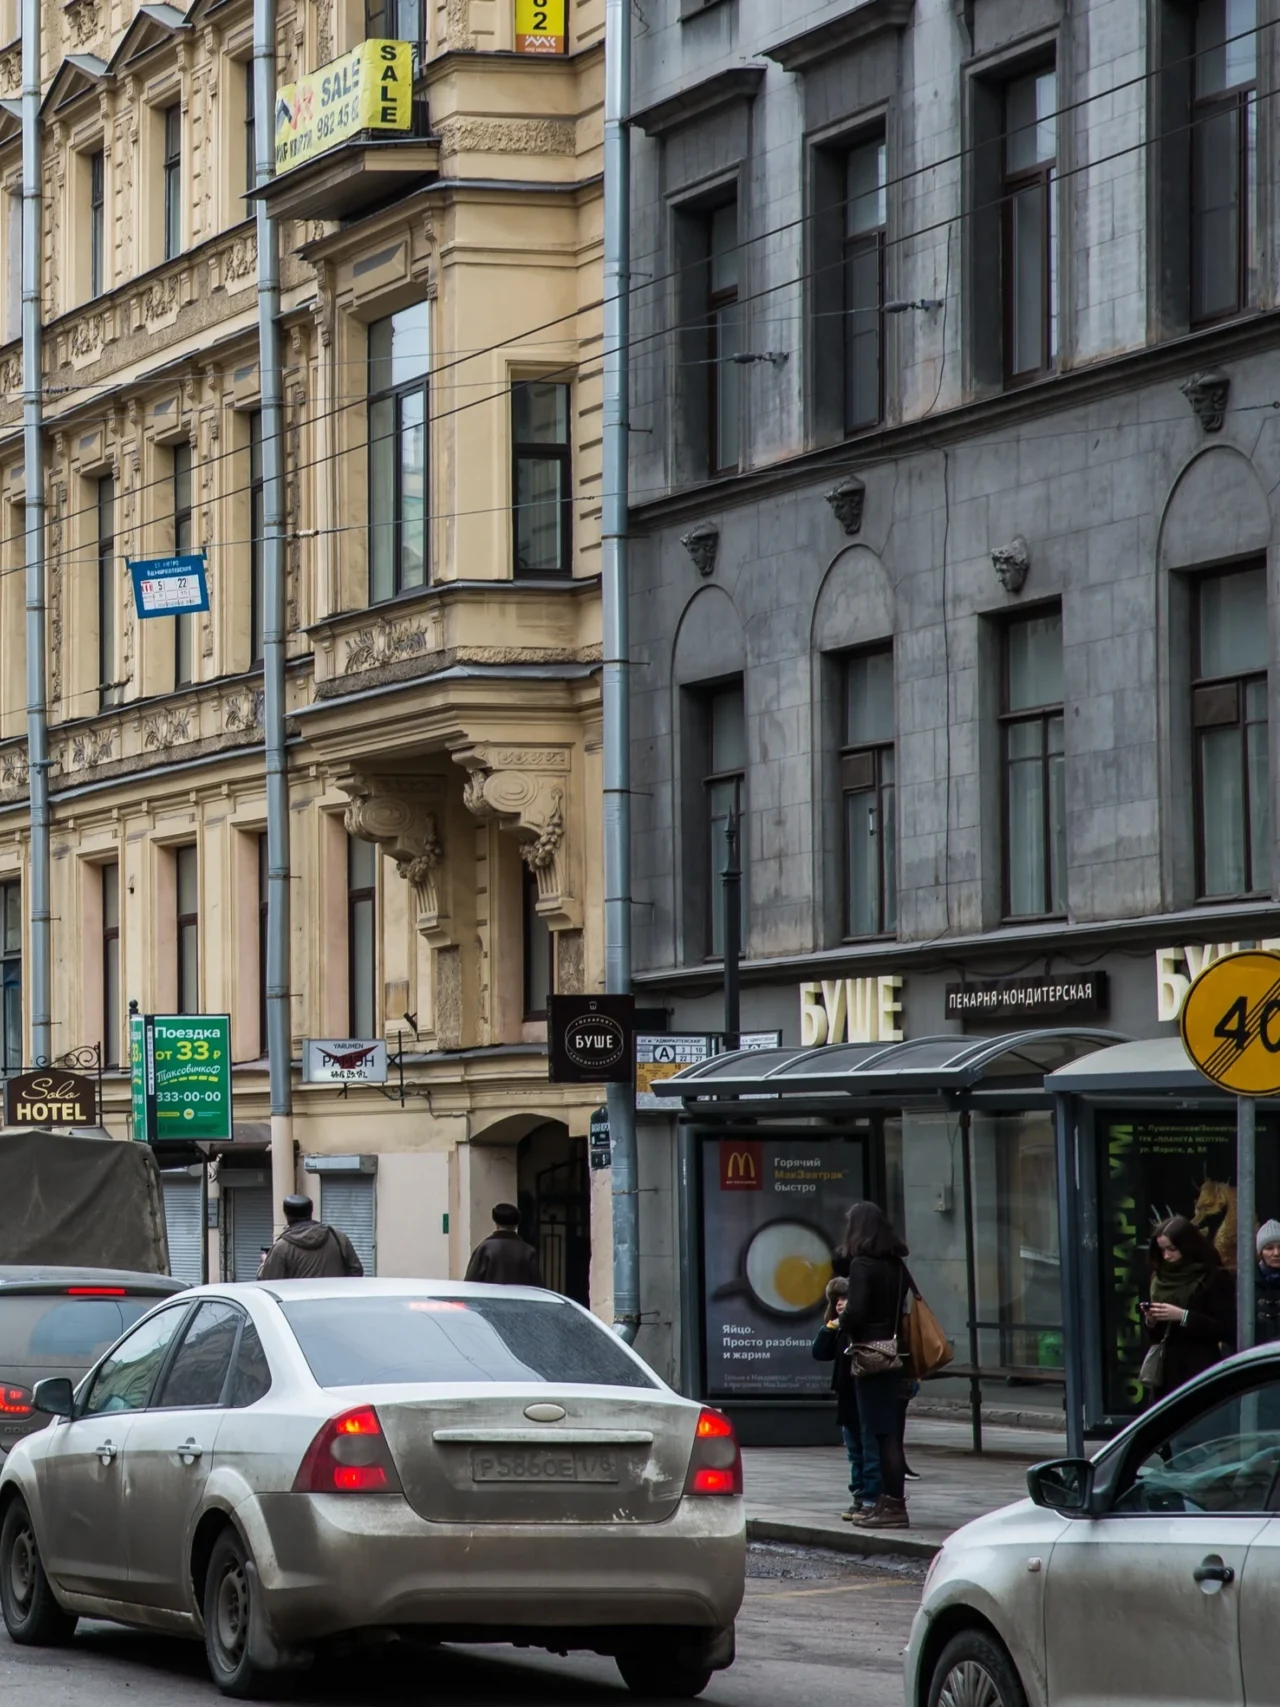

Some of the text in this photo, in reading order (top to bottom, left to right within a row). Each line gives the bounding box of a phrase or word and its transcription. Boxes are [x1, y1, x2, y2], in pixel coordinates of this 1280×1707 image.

[321, 58, 361, 108] SALE
[380, 45, 398, 124] SALE
[157, 577, 187, 591] 5 22
[800, 976, 904, 1048] БУШЕ
[154, 1027, 221, 1040] Поездка
[575, 1035, 613, 1048] БУШЕ
[156, 1050, 170, 1061] от
[176, 1041, 209, 1061] 33
[22, 1078, 81, 1100] Solo
[156, 1091, 221, 1102] 333-00-00
[16, 1103, 87, 1121] HOTEL
[774, 1157, 821, 1168] Горячий
[774, 1182, 817, 1193] быстро
[723, 1324, 755, 1336] Яйцо.
[723, 1337, 764, 1348] Просто
[732, 1351, 771, 1361] жарим
